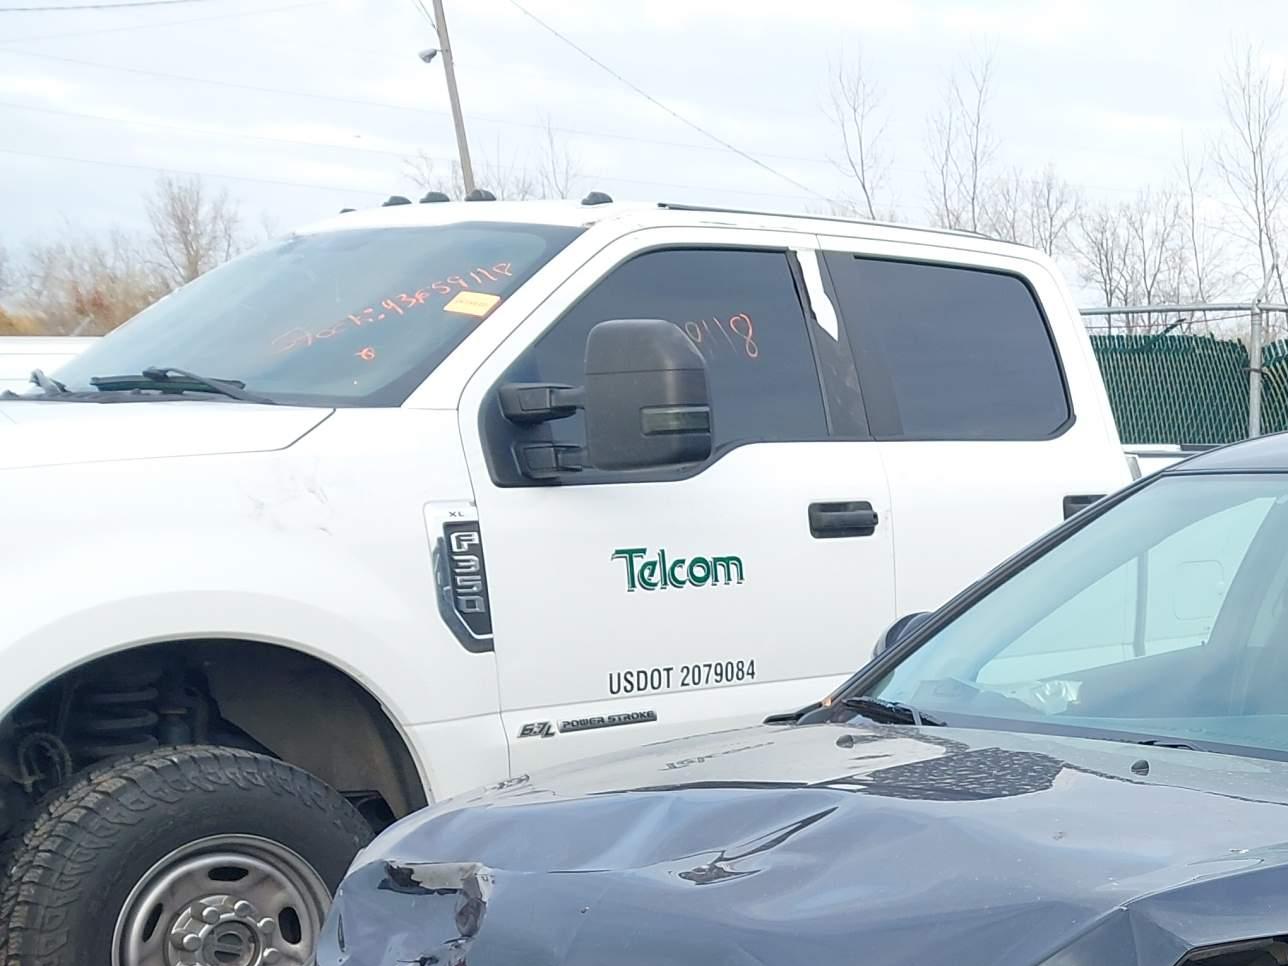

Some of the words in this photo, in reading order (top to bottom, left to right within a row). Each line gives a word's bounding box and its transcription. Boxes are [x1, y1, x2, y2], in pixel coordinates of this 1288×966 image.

[449, 531, 487, 613] F350
[610, 547, 745, 592] Telcom
[608, 666, 675, 695] USDOT
[680, 658, 757, 688] 2079084
[562, 715, 606, 730] POWER
[607, 709, 655, 723] STROKE
